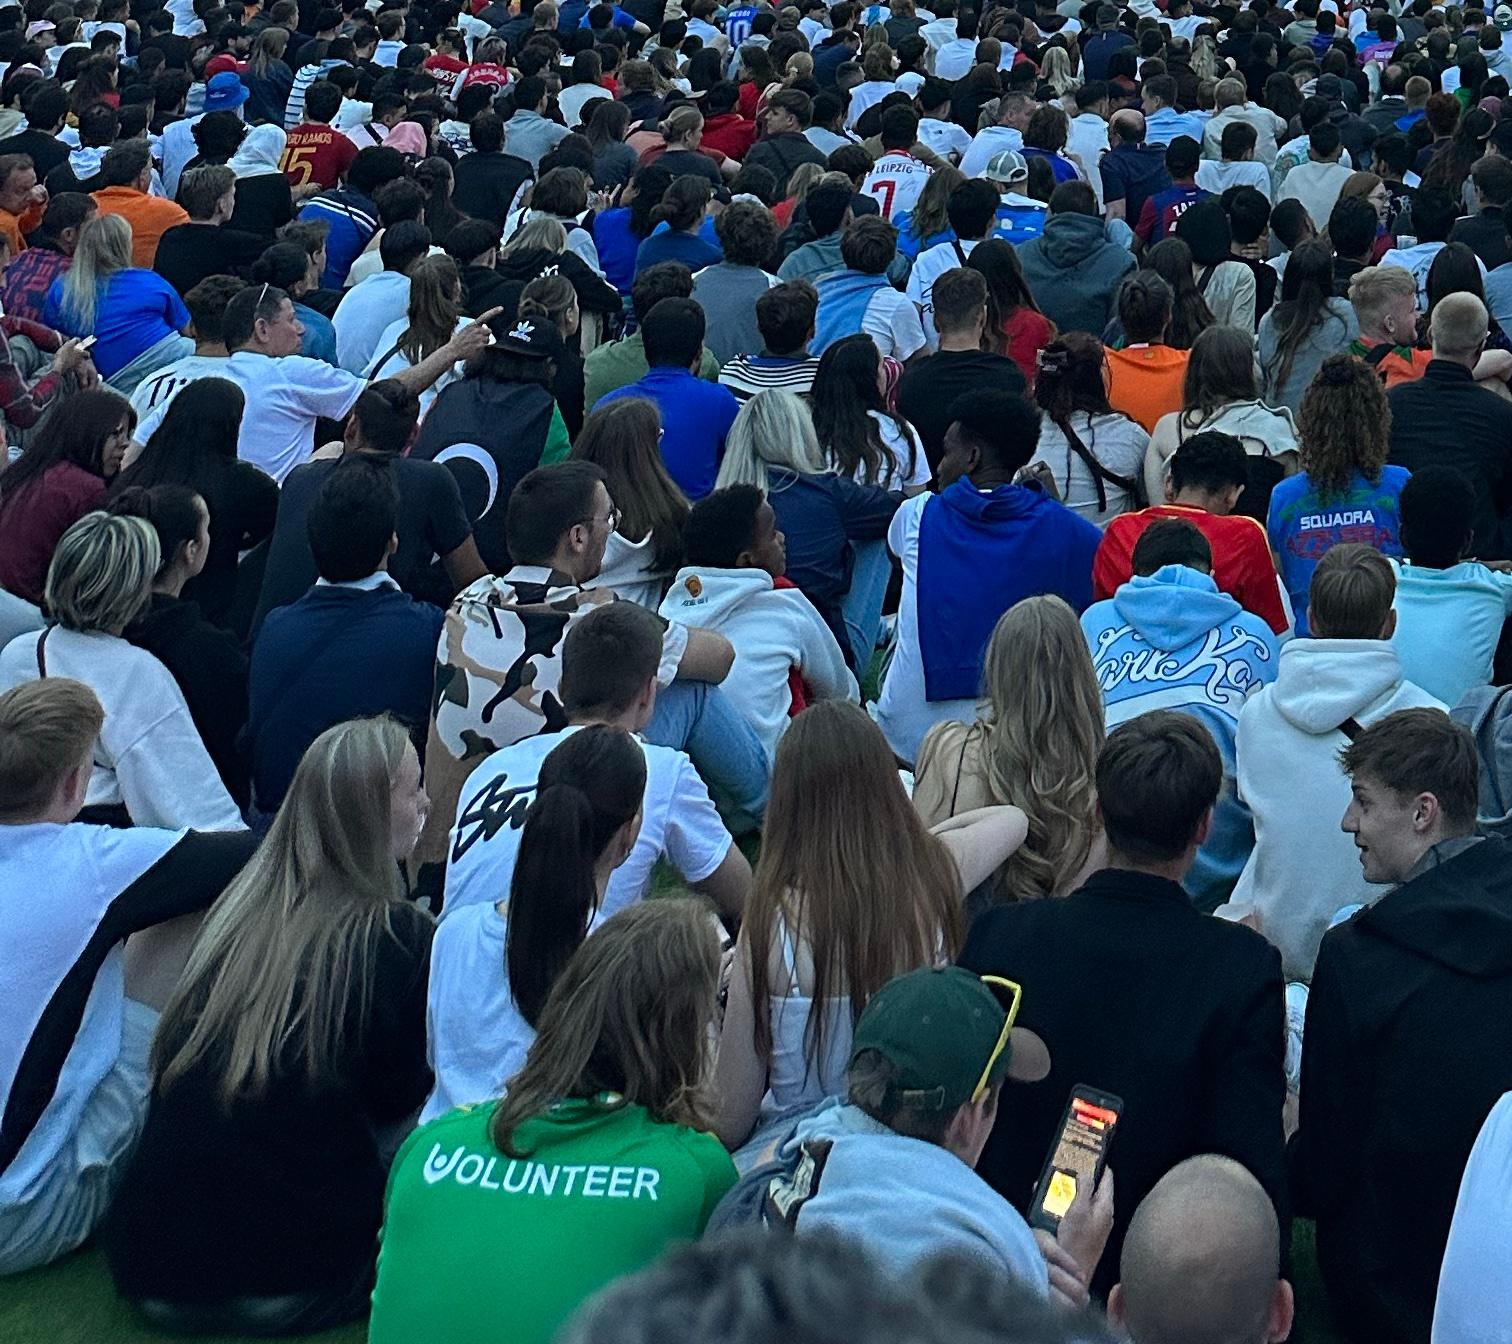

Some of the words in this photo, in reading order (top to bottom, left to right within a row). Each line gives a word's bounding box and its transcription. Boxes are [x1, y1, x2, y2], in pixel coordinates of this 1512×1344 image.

[726, 19, 751, 44] 10
[279, 146, 317, 188] 15
[875, 163, 914, 174] LEIPZIG
[1300, 510, 1375, 530] SQUADRA
[423, 1142, 661, 1201] VOLUNTEER
